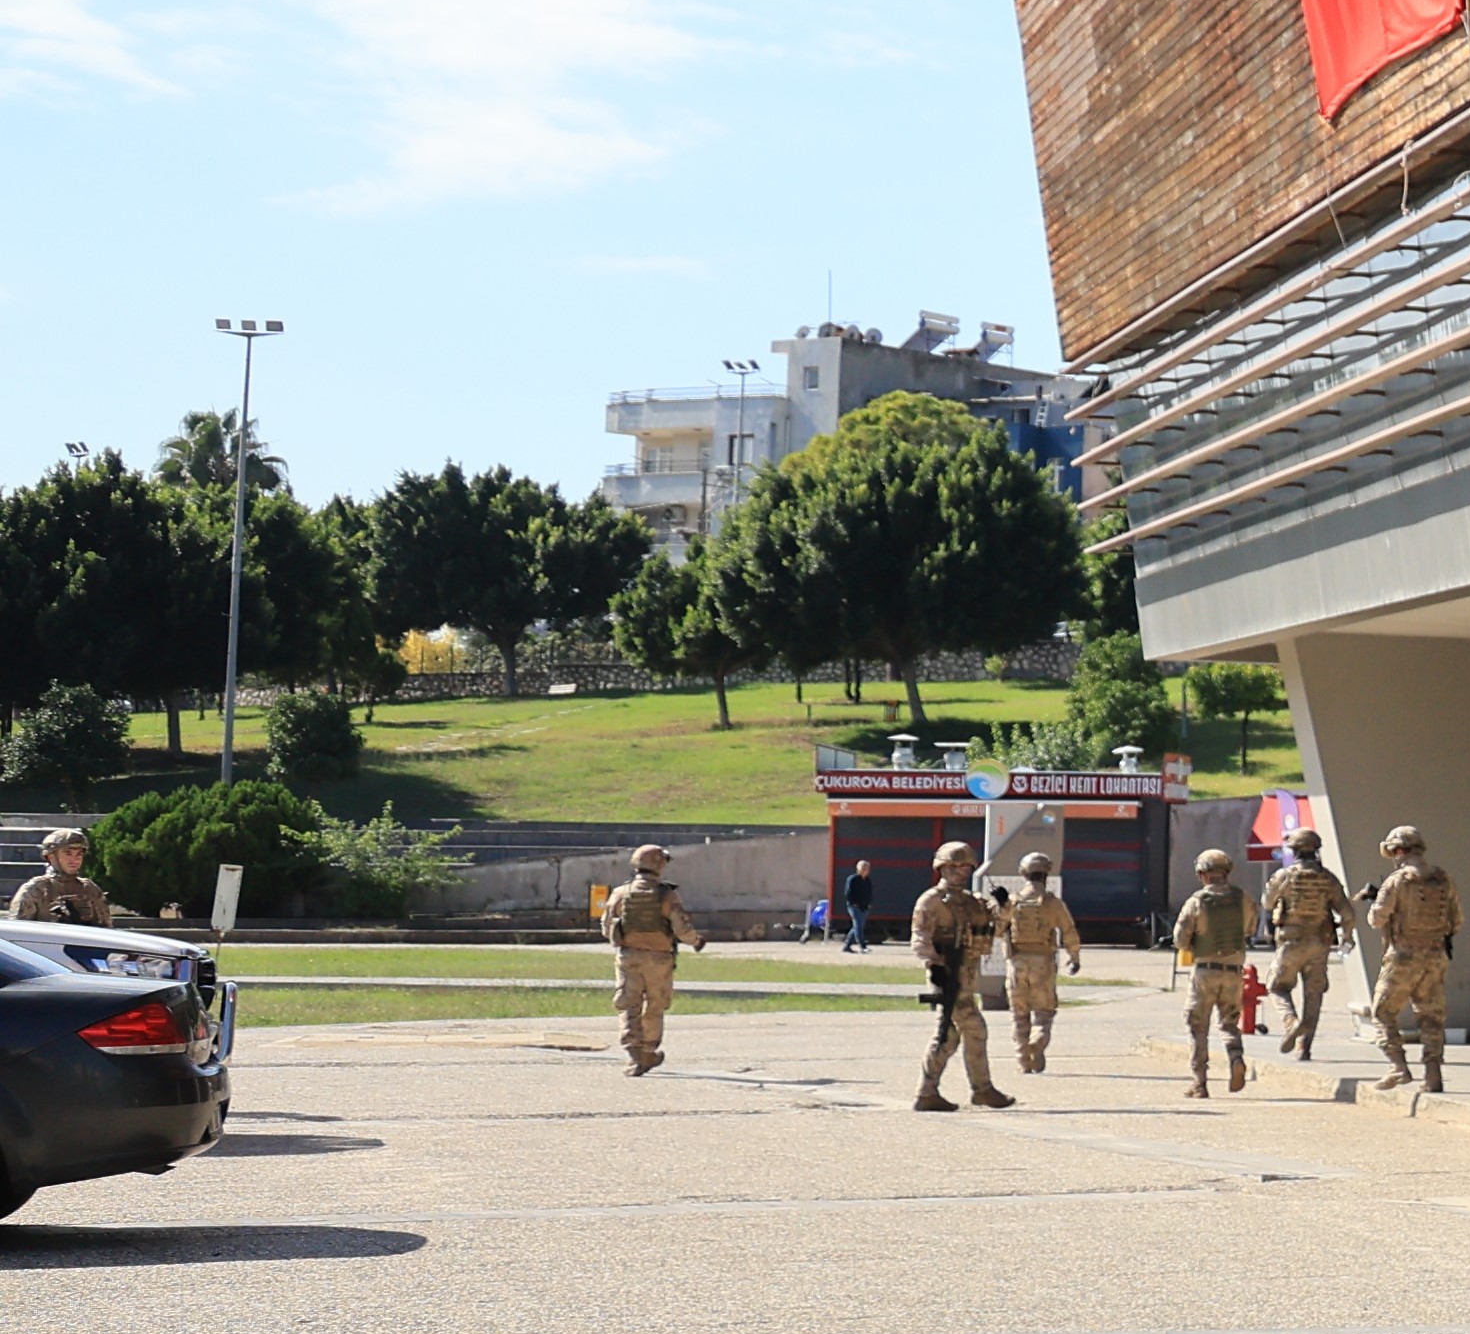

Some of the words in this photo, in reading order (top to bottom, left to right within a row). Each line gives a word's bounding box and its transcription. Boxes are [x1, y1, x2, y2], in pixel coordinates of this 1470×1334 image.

[814, 775, 890, 791] ÇUKUROVA
[891, 774, 966, 789] BELEDİYESİ
[1100, 777, 1162, 795] LOKANTASI
